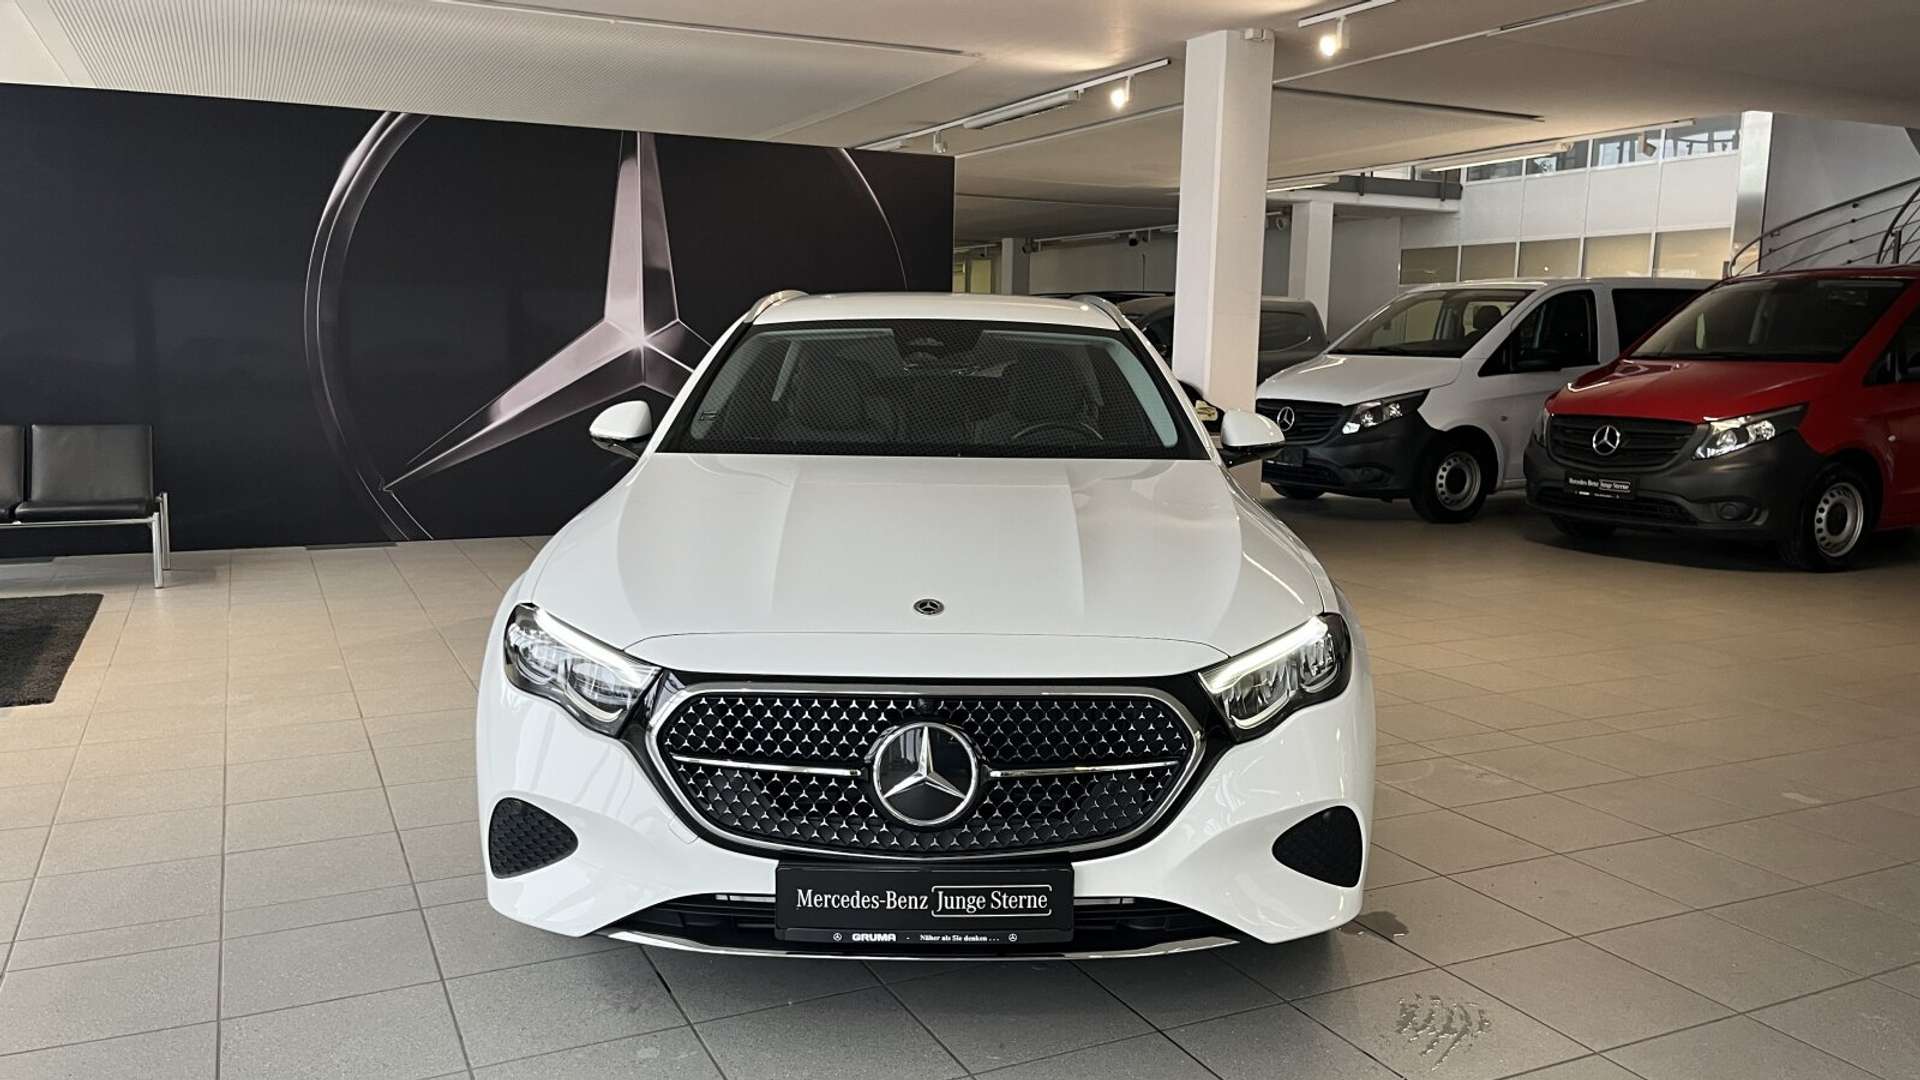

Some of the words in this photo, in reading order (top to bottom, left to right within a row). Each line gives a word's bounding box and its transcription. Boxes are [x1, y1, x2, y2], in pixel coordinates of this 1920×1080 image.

[796, 888, 929, 910] Mercedes-Benz
[936, 890, 986, 914] Junge
[990, 890, 1048, 910] Sterne
[852, 933, 897, 942] GRUMA
[920, 934, 940, 942] Näher
[941, 934, 951, 942] als
[952, 934, 963, 942] Sie
[963, 934, 988, 942] denken
